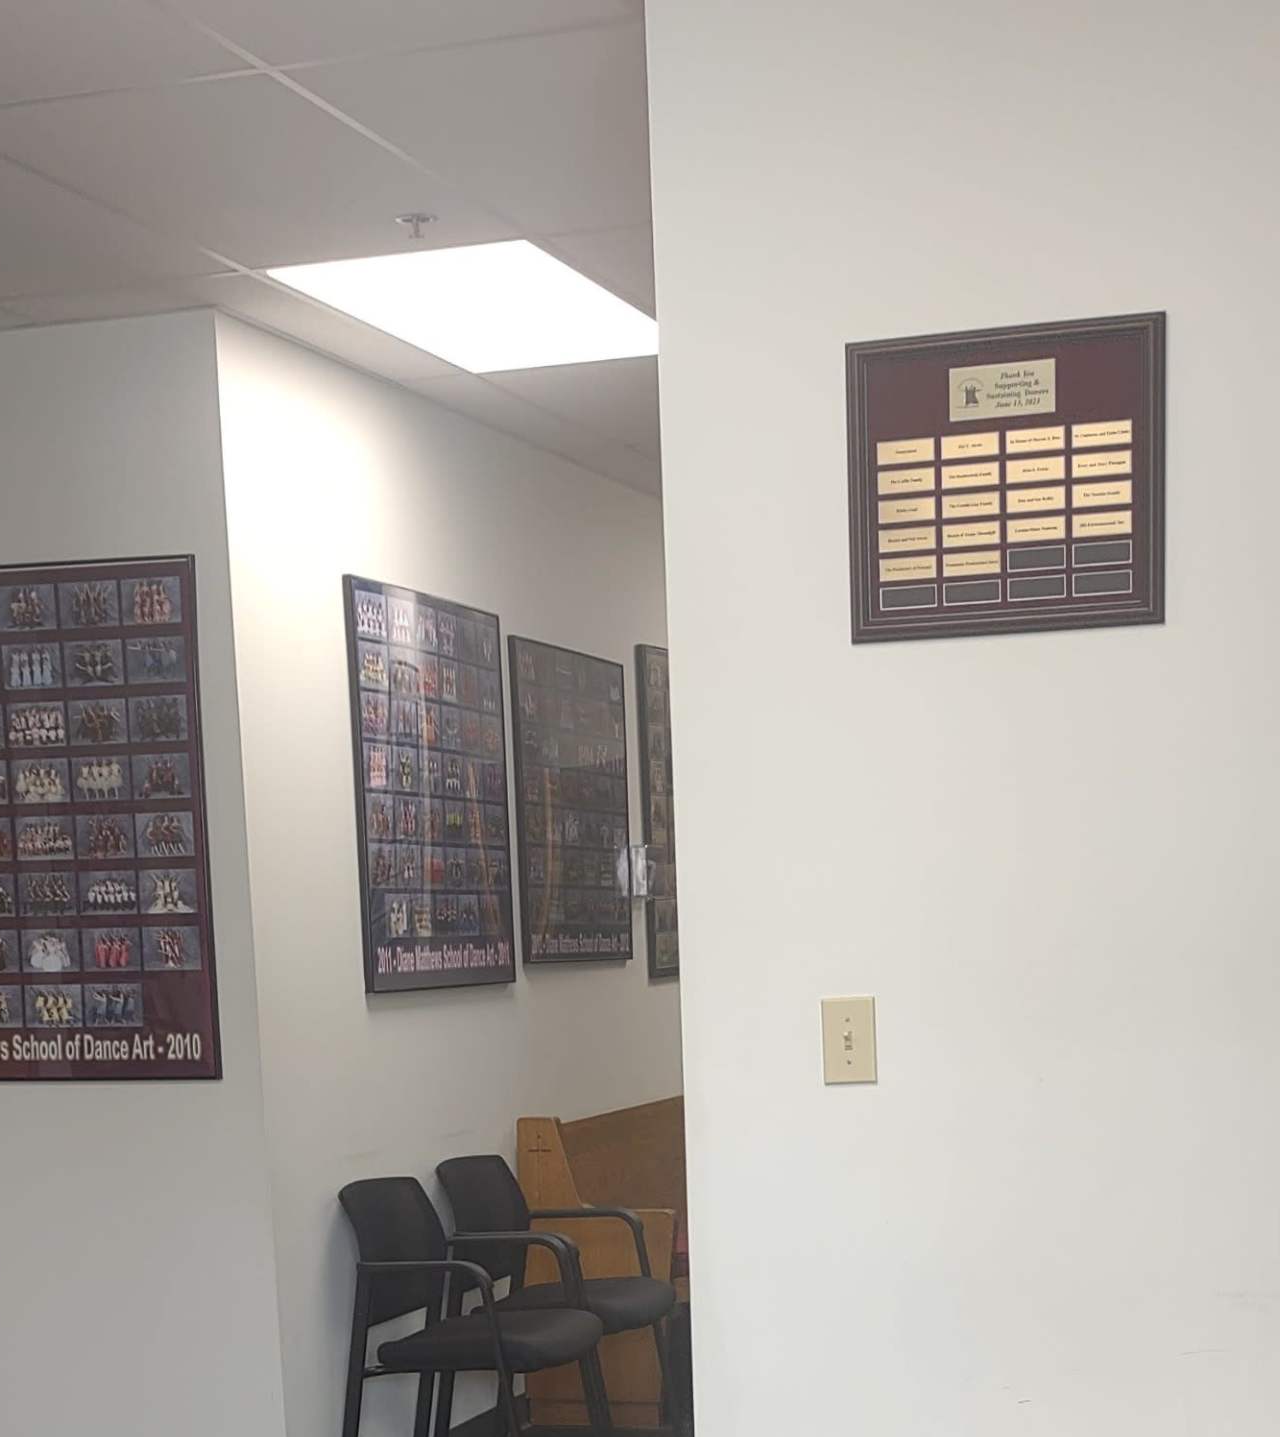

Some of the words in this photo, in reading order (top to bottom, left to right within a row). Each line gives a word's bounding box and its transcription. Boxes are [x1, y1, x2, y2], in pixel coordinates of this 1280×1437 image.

[12, 1034, 62, 1060] School
[65, 1034, 80, 1060] of
[83, 1034, 128, 1060] Dance
[132, 1033, 155, 1060] Art
[166, 1033, 201, 1060] 2010
